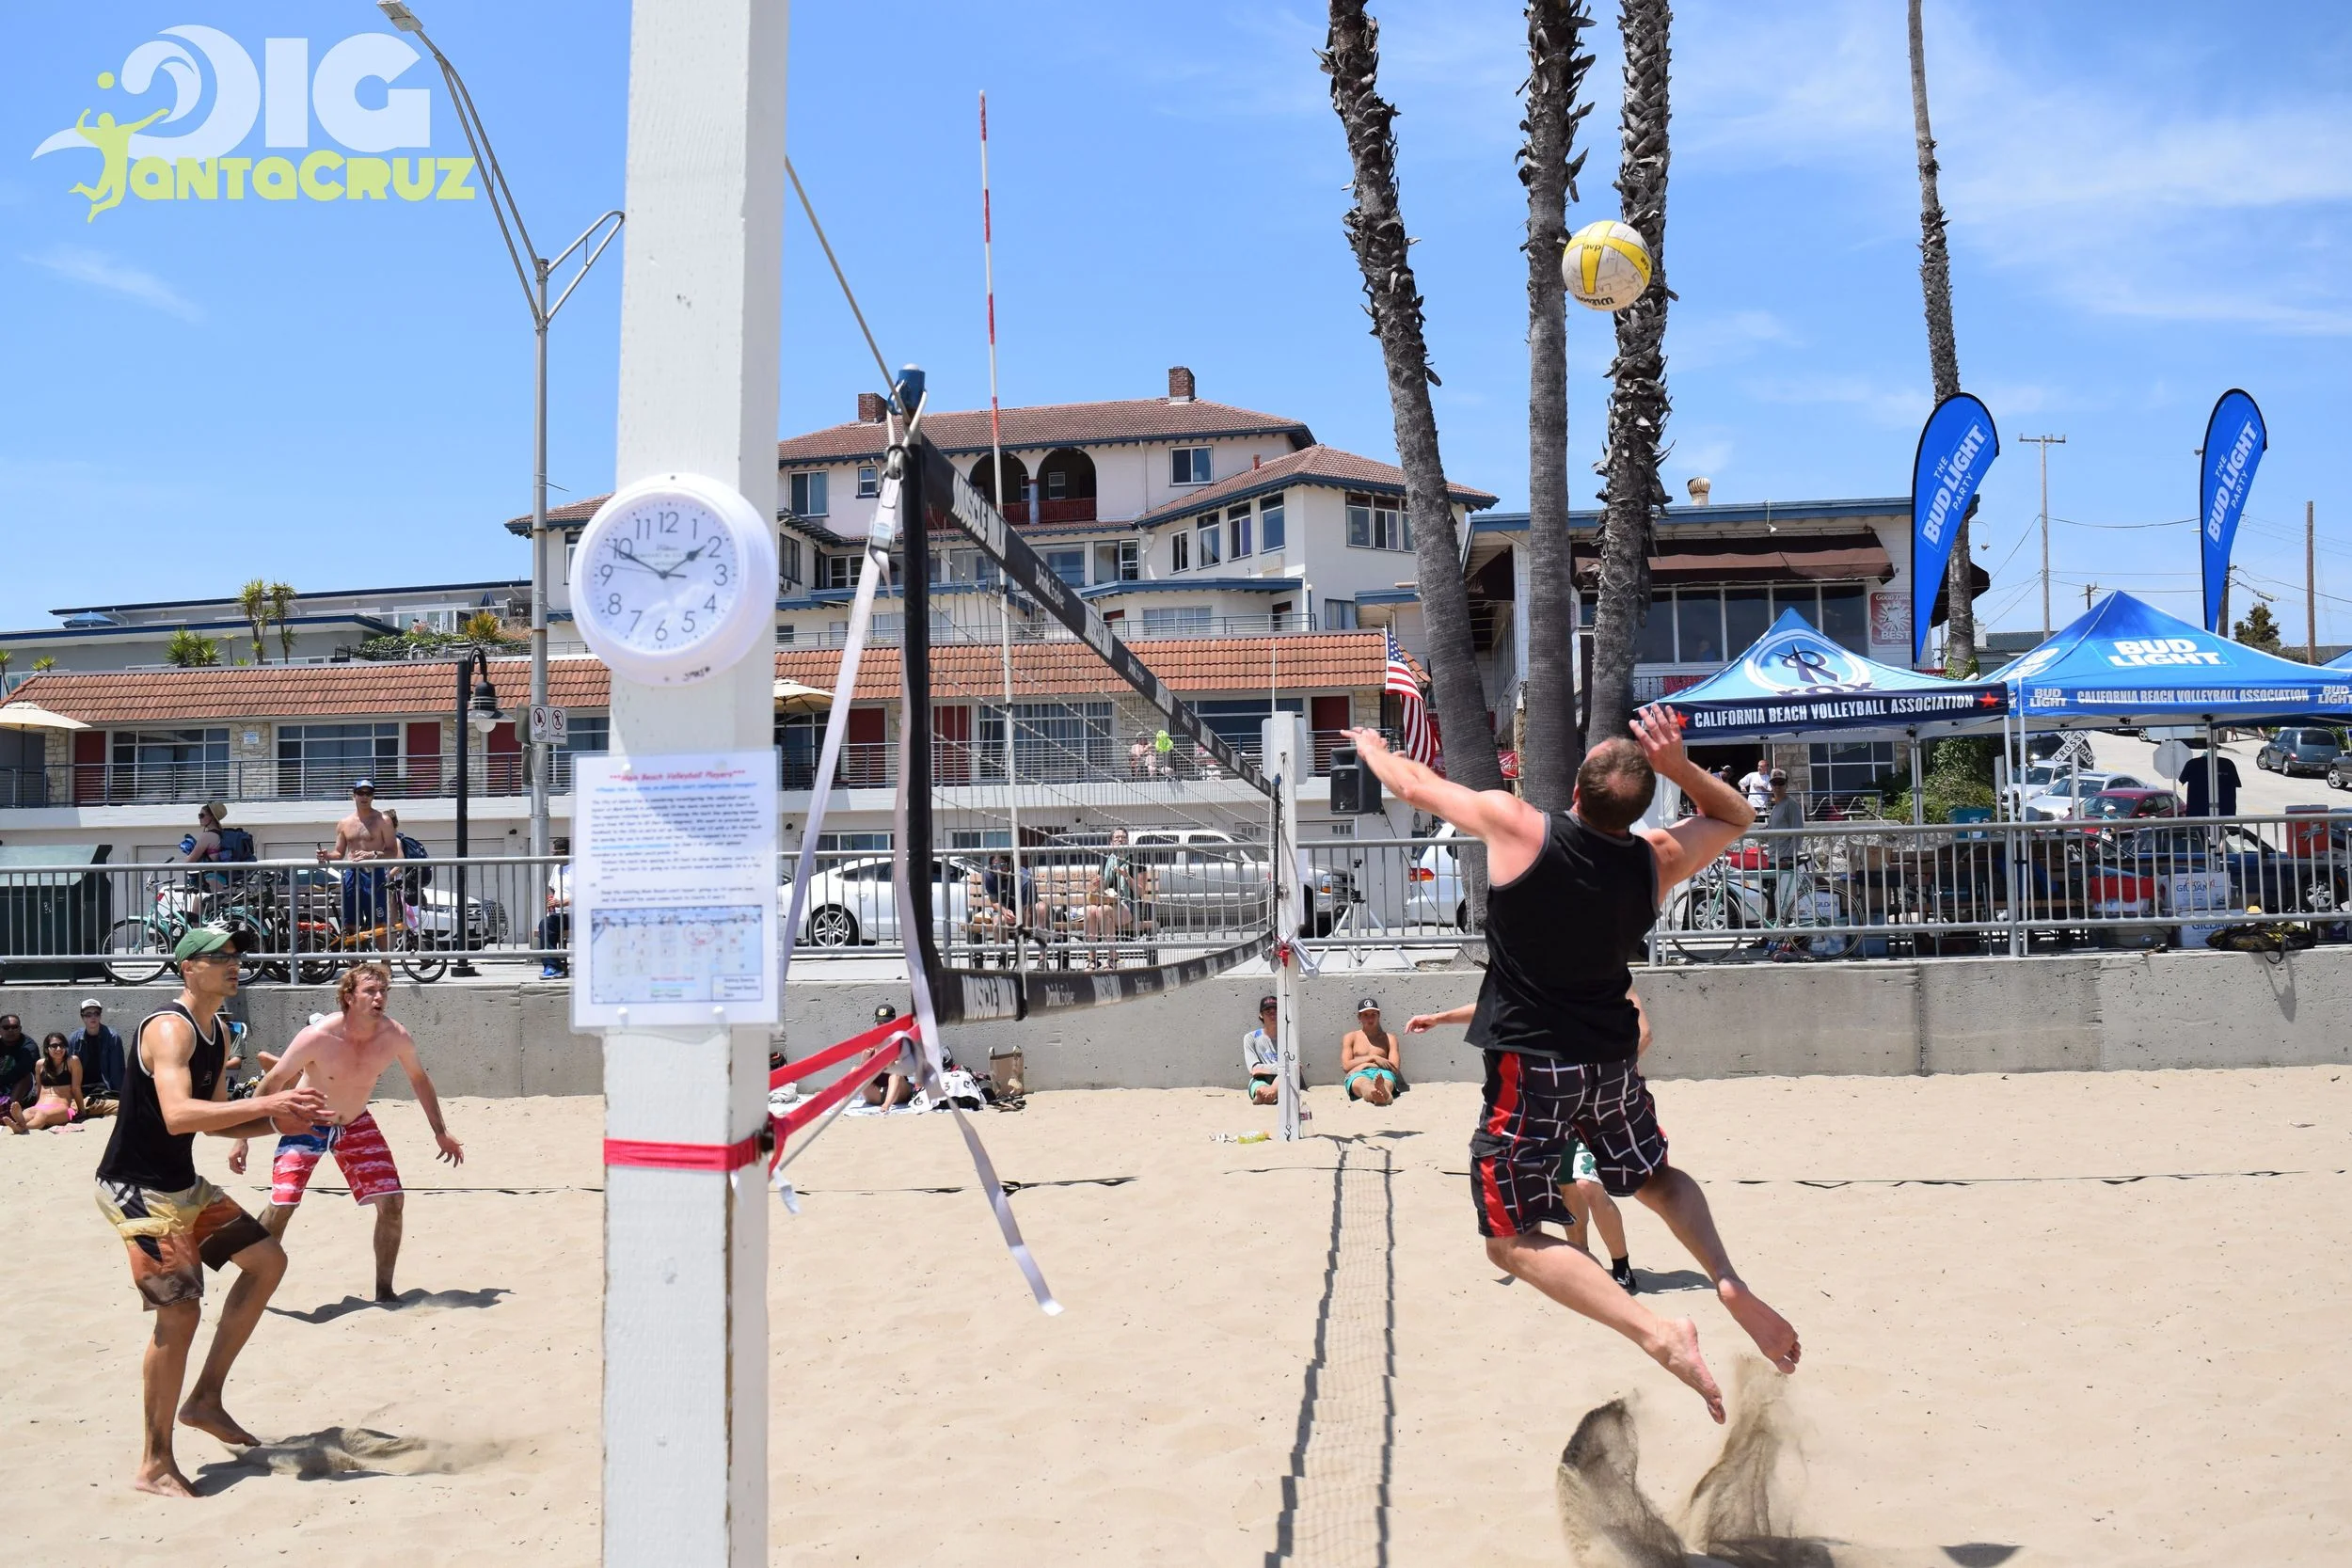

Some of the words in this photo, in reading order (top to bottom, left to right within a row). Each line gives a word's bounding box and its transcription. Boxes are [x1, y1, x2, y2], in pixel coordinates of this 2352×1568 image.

[1933, 455, 1948, 479] THE
[2215, 454, 2227, 478] THE
[1922, 486, 1951, 545] BUD
[1943, 424, 1987, 492] LIGHT
[1951, 471, 1975, 512] PARTY
[2207, 485, 2231, 543] BUD
[2222, 420, 2257, 490] LIGHT
[2231, 469, 2249, 509] PARTY
[635, 518, 651, 540] 11
[659, 512, 679, 533] 12
[691, 518, 697, 540] 1
[612, 538, 633, 560] 10
[707, 536, 722, 558] 2
[600, 564, 613, 586] 9
[713, 563, 728, 586] 3
[608, 593, 622, 615] 8
[703, 594, 717, 613] 4
[629, 610, 643, 632] 7
[655, 619, 668, 641] 6
[682, 610, 695, 633] 5
[1882, 631, 1911, 640] BEST
[2113, 639, 2197, 656] BUD
[2107, 653, 2223, 667] LIGHT
[2034, 689, 2061, 698] BUD
[2076, 690, 2138, 704] CALIFORNIA
[2140, 690, 2174, 704] BEACH
[2177, 690, 2238, 703] VOLLEYBALL
[2240, 689, 2310, 703] ASSOCIATION
[2322, 686, 2349, 695] BUD
[1694, 707, 1766, 728] CALIFORNIA
[1769, 705, 1807, 722] BEACH
[1810, 699, 1887, 720] VOLLEYBALL
[1891, 694, 1975, 715] ASSOCIATION
[2029, 697, 2068, 707] LIGHT
